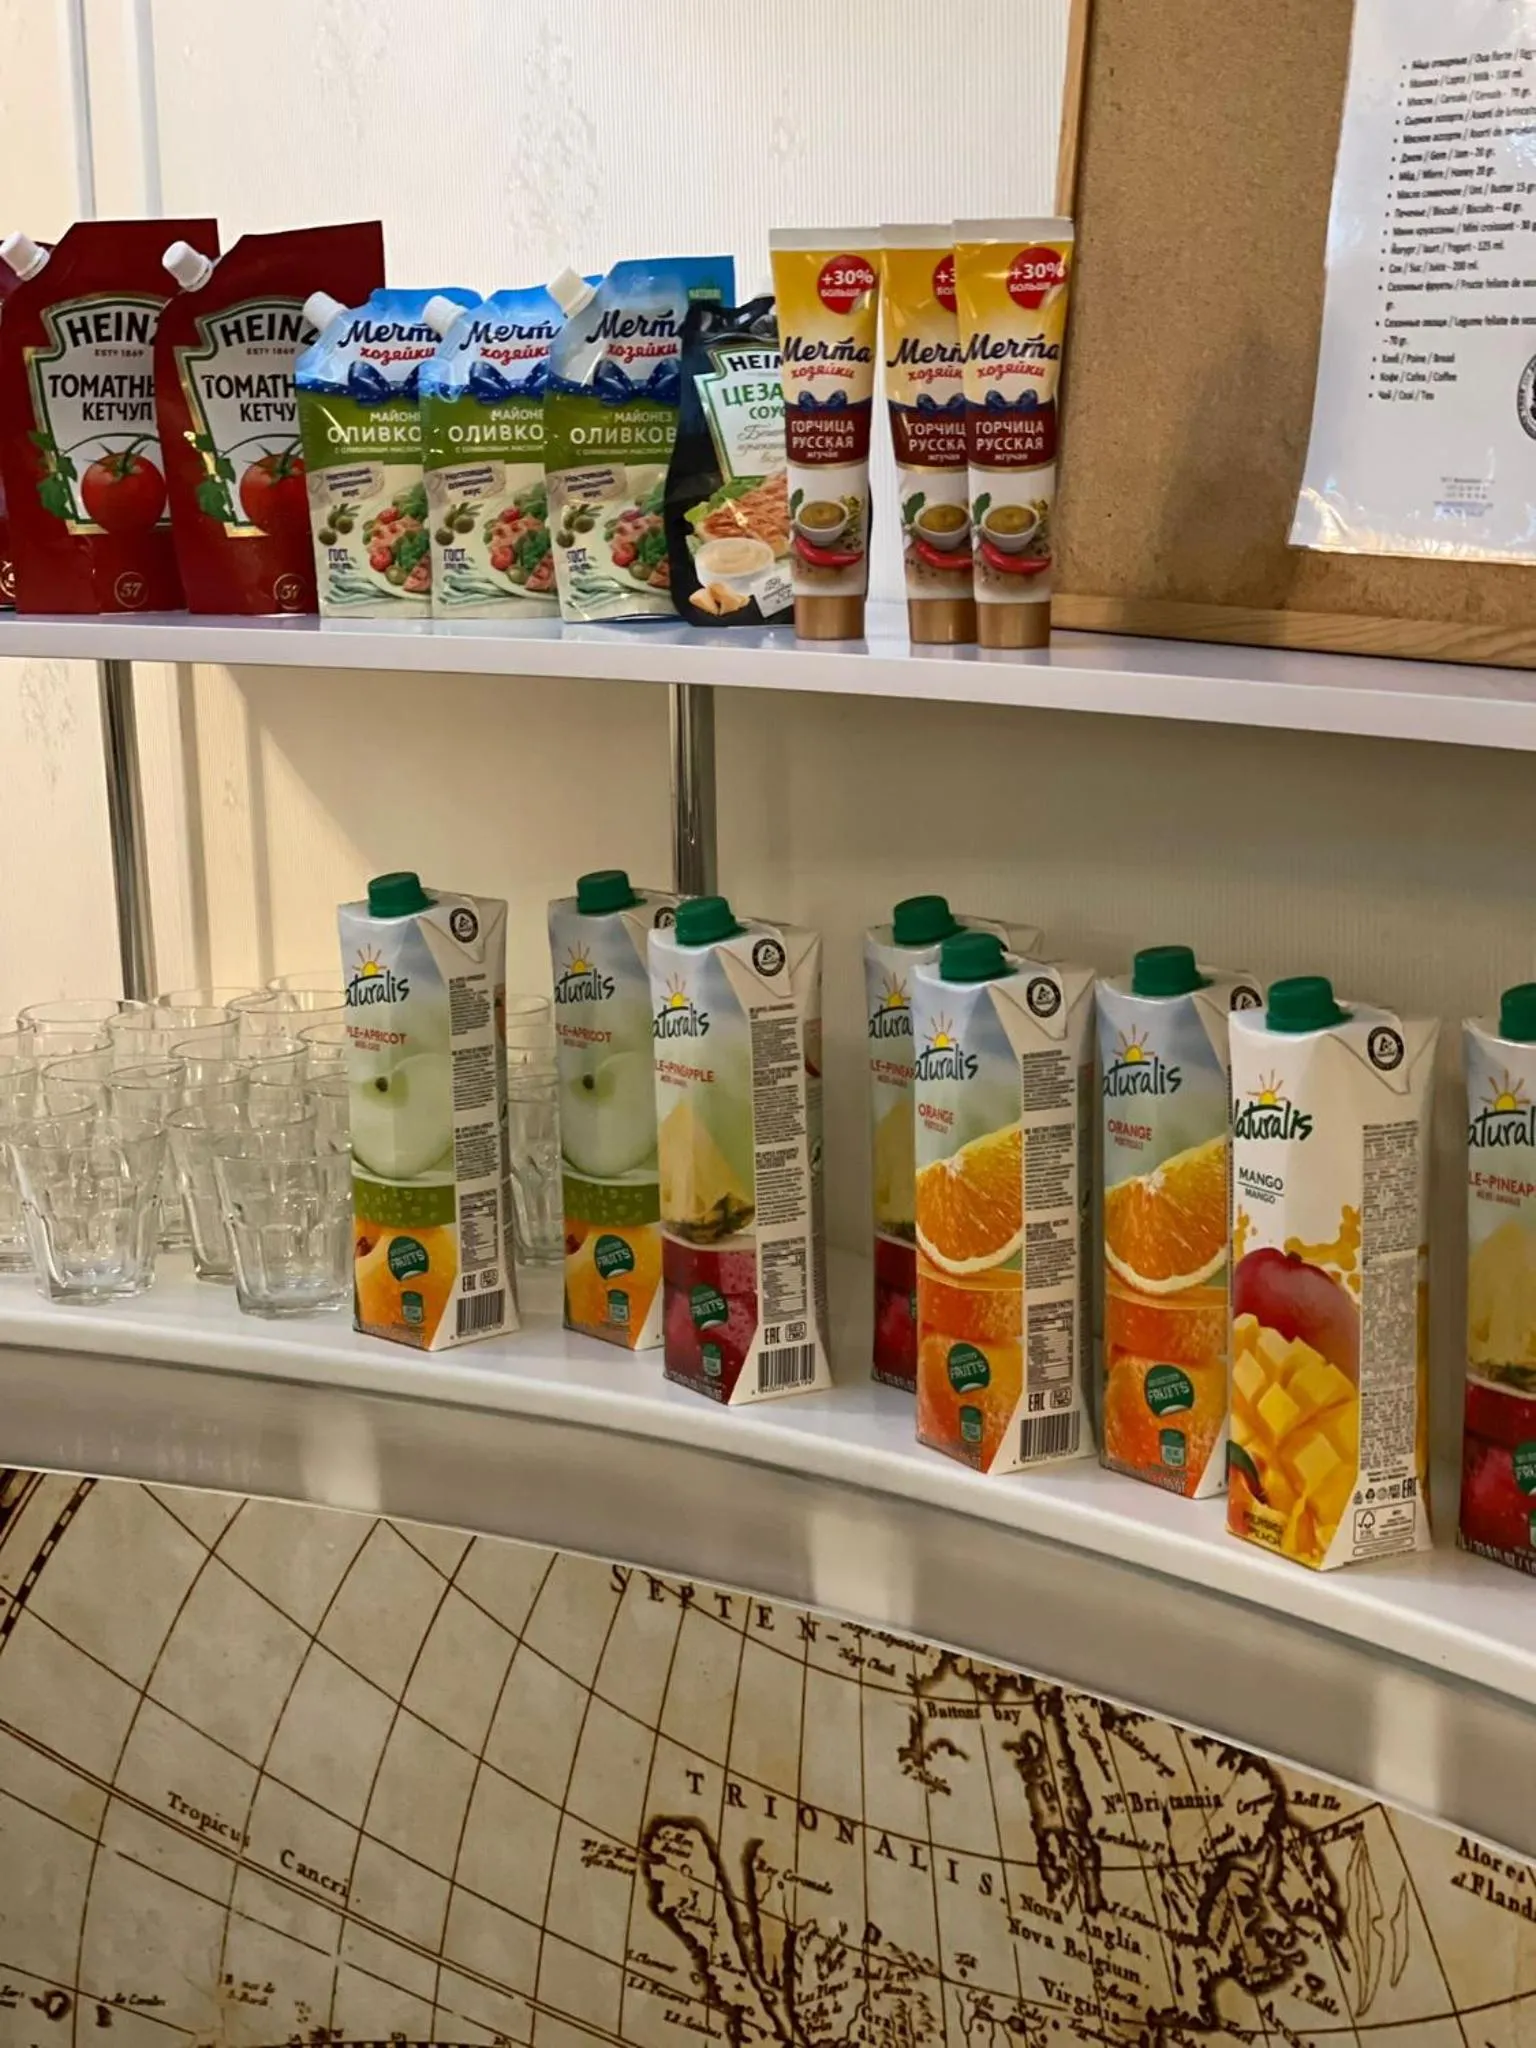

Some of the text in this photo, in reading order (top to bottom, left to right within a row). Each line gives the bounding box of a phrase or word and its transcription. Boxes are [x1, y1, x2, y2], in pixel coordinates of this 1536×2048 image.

[821, 270, 874, 286] +30%
[1010, 262, 1066, 280] +30%
[338, 320, 442, 348] Мечт
[121, 349, 144, 359] 1869
[360, 345, 436, 370] хозяйки
[606, 342, 678, 367] хозяйки
[781, 336, 874, 366] Мечта
[963, 333, 1061, 364] Мечта
[791, 364, 855, 380] хозяйки
[976, 361, 1045, 381] хозяйки
[722, 384, 784, 407] ЦЕЗА
[82, 402, 153, 422] КЕТЧУП
[240, 403, 296, 422] КЕТЧУ
[614, 411, 673, 424] МАЙОНЕЗ
[448, 425, 544, 443] ОЛИВКО
[570, 427, 677, 445] ОЛИВКОВ
[791, 419, 855, 434] ГОРЧИЦА
[906, 421, 966, 436] ГОРЧИЦ
[975, 419, 1044, 435] ГОРЧИЦА
[791, 435, 855, 450] РУССКАЯ
[908, 438, 966, 451] РУССКА
[976, 436, 1044, 451] РУССКАЯ
[119, 582, 144, 599] 57
[915, 1043, 980, 1082] aturalis
[1102, 1057, 1183, 1098] aturalis
[918, 1103, 955, 1126] ORANGE
[1107, 1119, 1152, 1141] ORANGE
[1238, 1166, 1284, 1191] MANGO
[1244, 1188, 1276, 1205] MANGO
[764, 1326, 782, 1346] EAC
[1028, 1392, 1046, 1412] EAC
[993, 1700, 1022, 1726] bay
[166, 1789, 252, 1848] Tropicus
[279, 1848, 351, 1900] Cancri
[1019, 1893, 1064, 1925] Nova
[1007, 1915, 1055, 1950] Nova
[1038, 1975, 1121, 2025] Virginia
